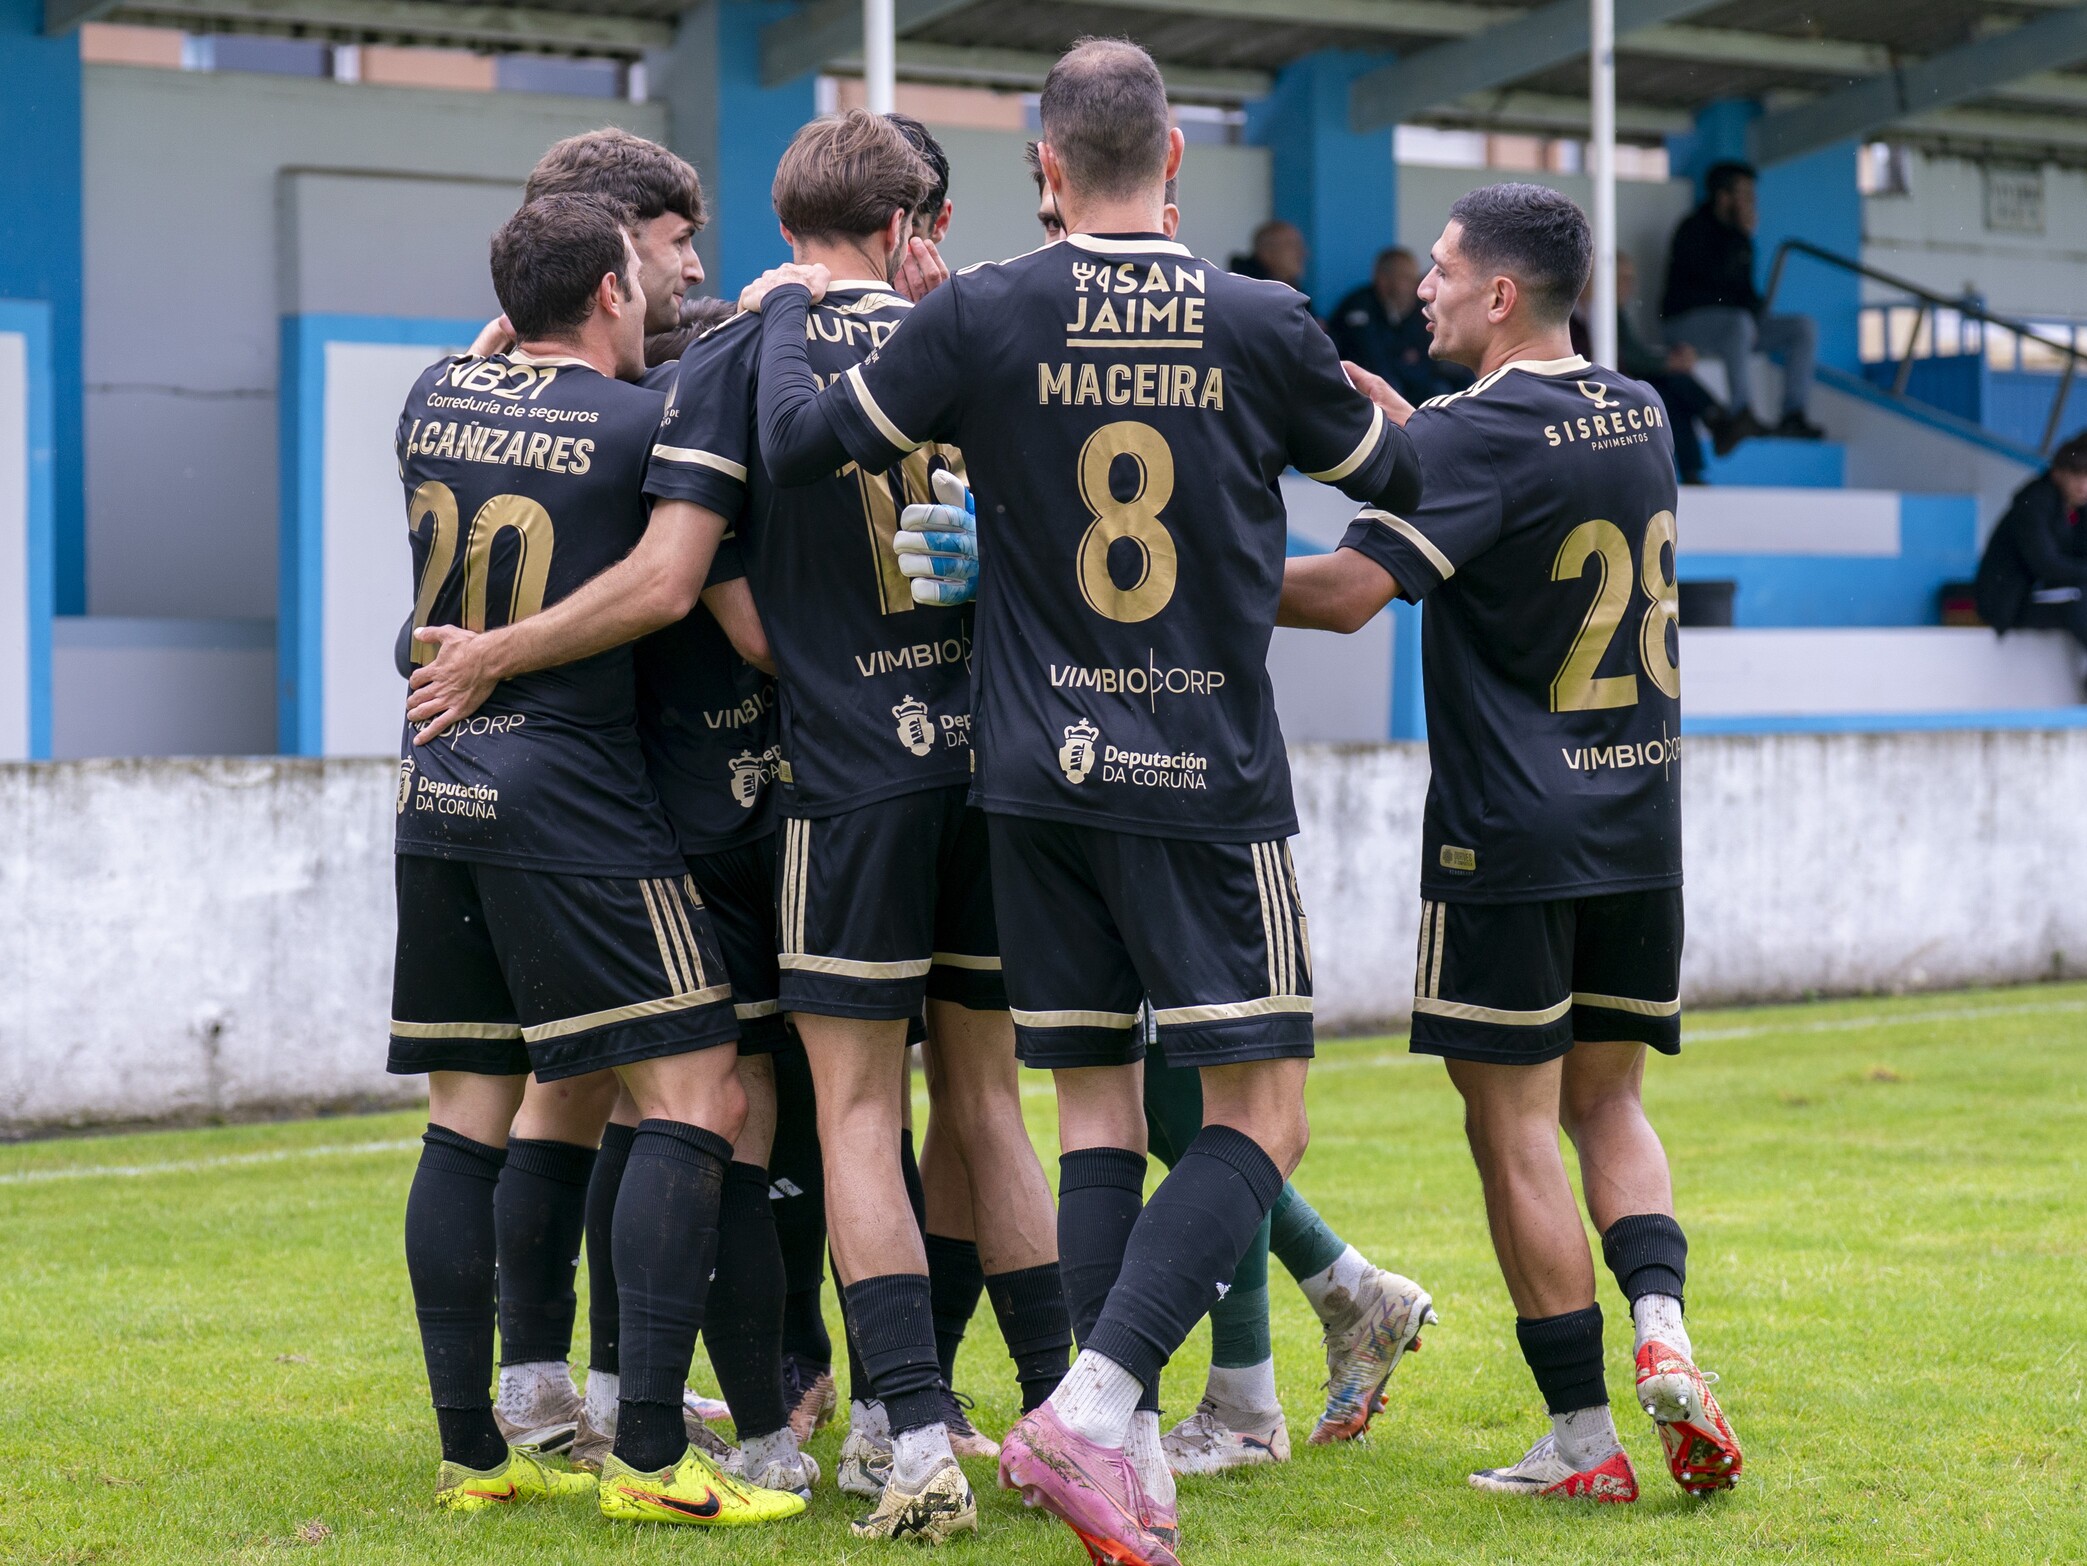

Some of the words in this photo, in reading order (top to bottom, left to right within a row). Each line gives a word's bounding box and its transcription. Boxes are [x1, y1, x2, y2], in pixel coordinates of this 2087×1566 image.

[1114, 262, 1205, 294] SAN
[1066, 296, 1206, 334] JAIME
[435, 361, 557, 400] NB21
[1038, 362, 1224, 411] MACEIRA
[426, 392, 501, 415] Correduría
[503, 402, 526, 418] de
[528, 406, 600, 424] seguros
[1544, 405, 1663, 447] SISRECON
[1591, 432, 1649, 451] PAVIMENTOS
[1076, 420, 1178, 624] 8
[408, 480, 554, 666] 20
[1550, 510, 1680, 713] 28
[945, 731, 969, 748] DA
[1104, 745, 1208, 771] Deputación
[417, 776, 499, 802] Deputación
[1102, 765, 1127, 784] DA
[1132, 768, 1208, 790] CORUÑA
[415, 794, 434, 812] DA
[437, 797, 498, 820] CORUÑA
